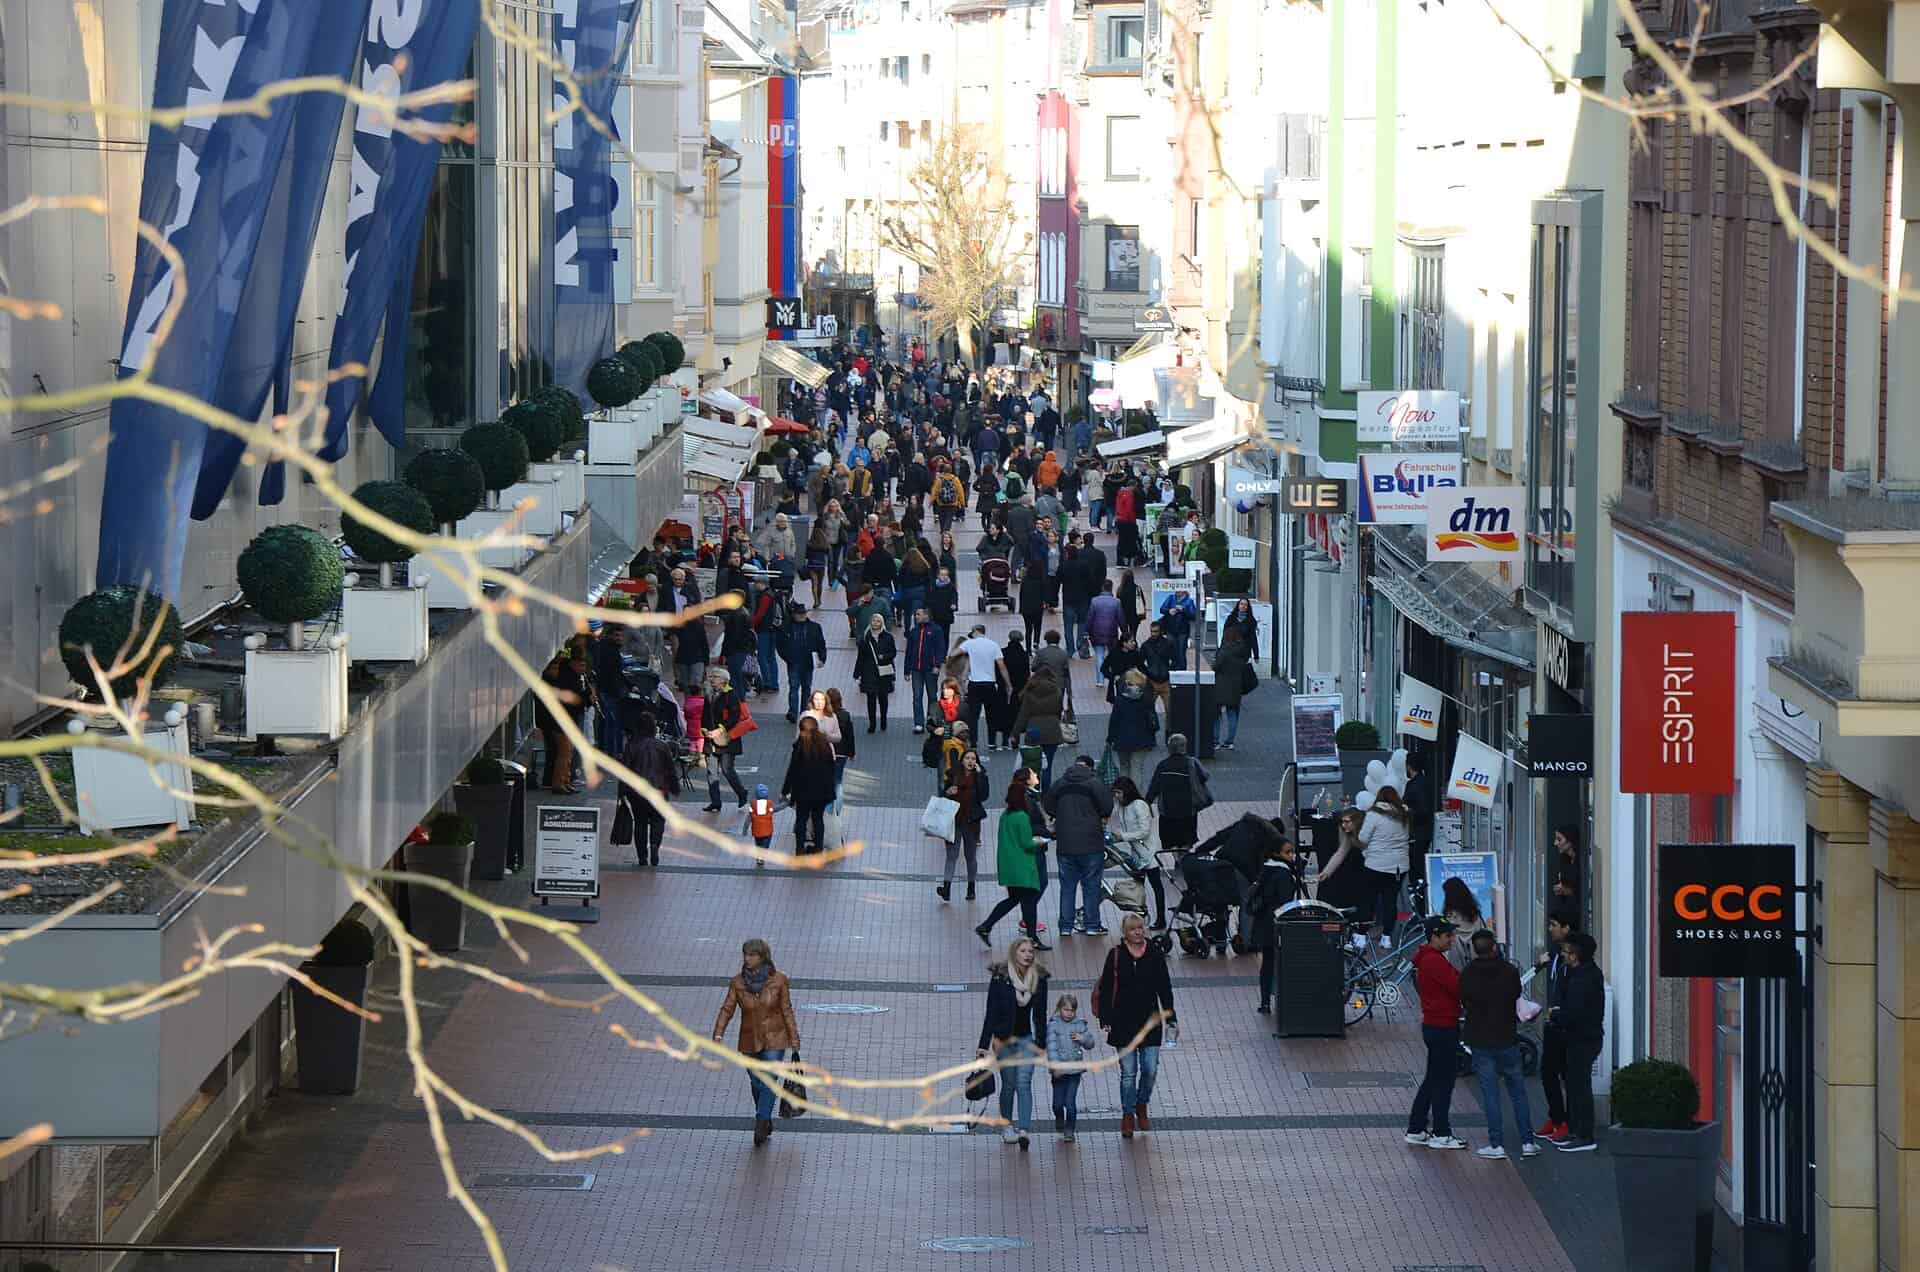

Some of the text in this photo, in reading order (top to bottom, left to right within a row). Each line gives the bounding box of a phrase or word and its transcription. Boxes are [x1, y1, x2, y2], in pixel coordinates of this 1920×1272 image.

[1377, 396, 1436, 441] Now
[1403, 463, 1457, 472] Fahrschule
[1235, 482, 1272, 493] ONLY
[1289, 483, 1339, 507] WE
[1449, 497, 1511, 532] dm
[1409, 704, 1433, 721] dm
[1662, 643, 1694, 763] ESPRIT
[1533, 761, 1588, 772] MANGO
[1463, 767, 1490, 786] dm
[1673, 883, 1783, 921] CCC
[1676, 929, 1783, 940] SHOES & BAGS
